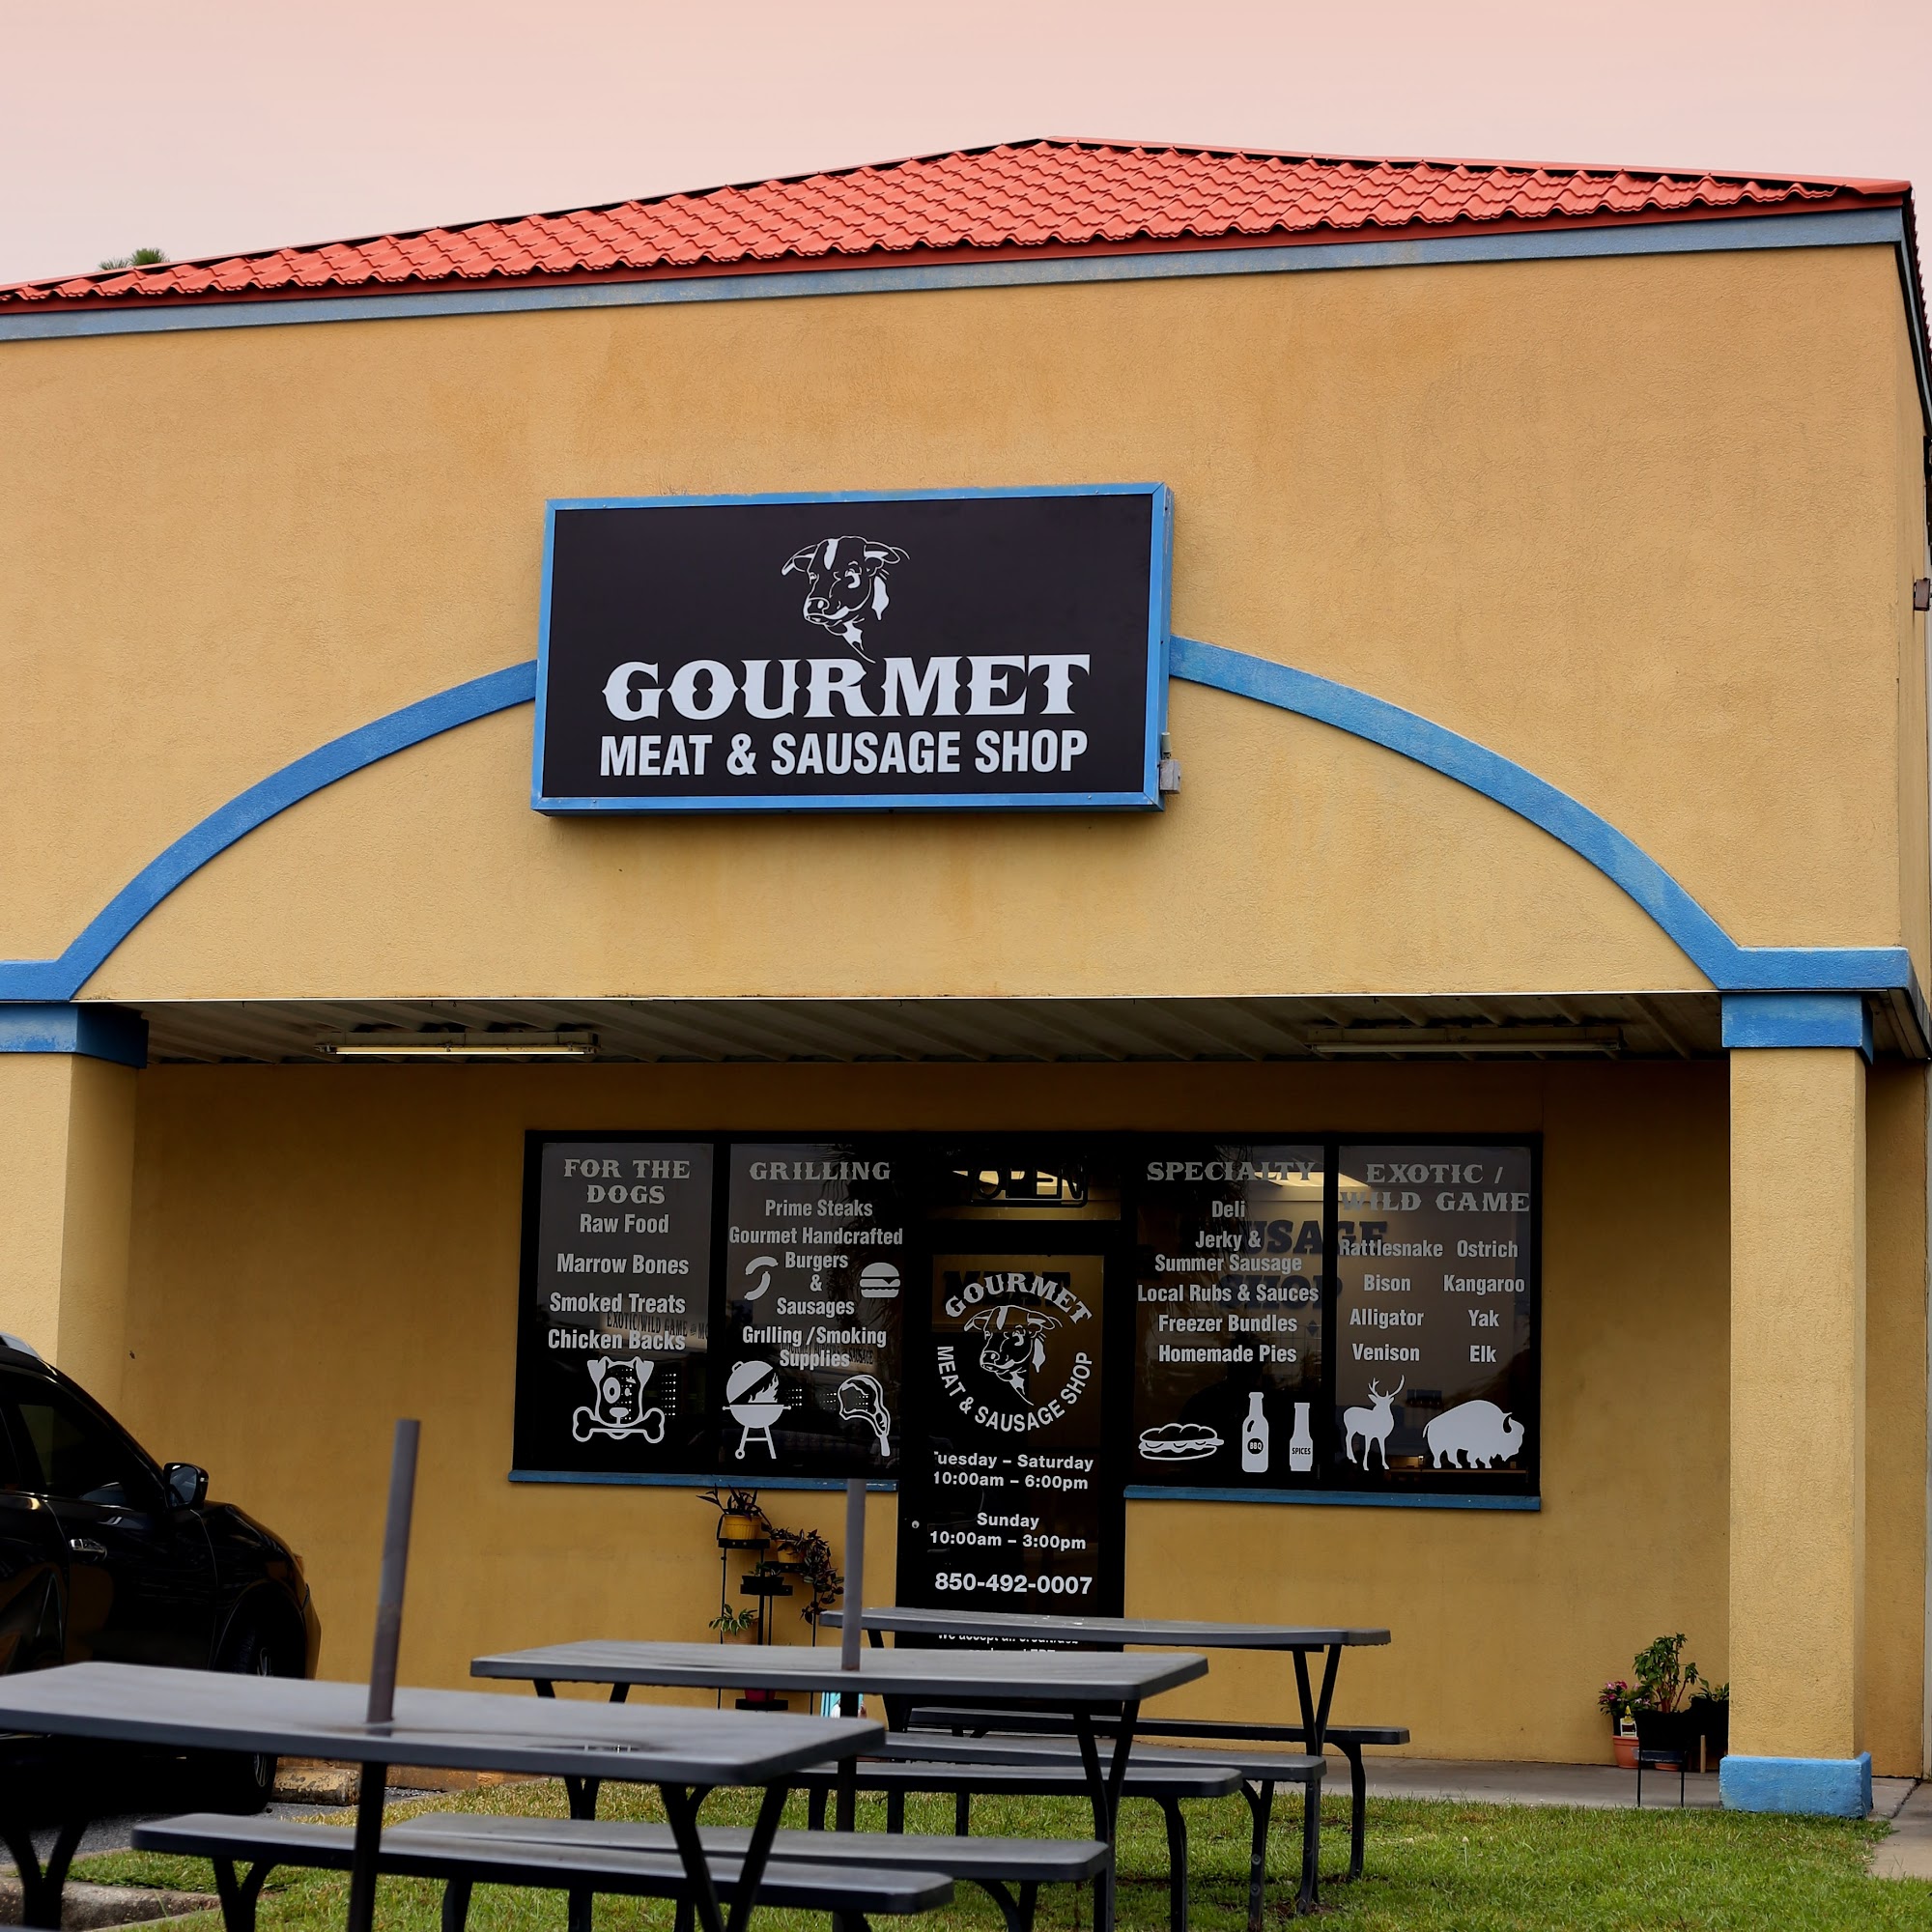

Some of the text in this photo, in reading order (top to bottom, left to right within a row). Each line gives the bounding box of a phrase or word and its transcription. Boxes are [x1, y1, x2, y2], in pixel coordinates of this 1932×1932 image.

[602, 654, 1091, 722] GOURMET
[600, 729, 1089, 777] MEAT & SAUSAGE SHOP
[563, 1158, 691, 1179] FOR THE
[749, 1161, 891, 1181] GRILLING
[1147, 1161, 1316, 1182] SPECIALTY
[1366, 1163, 1503, 1184] EXOTIC /
[586, 1184, 666, 1205] DOGS
[1340, 1191, 1530, 1212] WILD GAME
[765, 1199, 873, 1217] Prime Steaks
[1211, 1200, 1245, 1218] Deli
[580, 1213, 669, 1234] Raw Food
[728, 1226, 903, 1246] Gourmet Handcrafted
[1195, 1231, 1262, 1252] Jerky &
[1339, 1239, 1443, 1258] Rattlesnake
[1457, 1239, 1519, 1259] Ostrich
[556, 1253, 689, 1275] Marrow Bones
[784, 1252, 848, 1273] Burgers
[1154, 1254, 1302, 1275] Summer Sausage
[810, 1274, 823, 1293] &
[1137, 1284, 1320, 1303] Local Rubs & Sauces
[1363, 1274, 1411, 1293] Bison
[1443, 1275, 1526, 1295] Kangaroo
[550, 1293, 686, 1314] Smoked Treats
[777, 1297, 855, 1319] Sausages
[945, 1273, 1093, 1323] GOURMET
[1158, 1315, 1297, 1333] Freezer Bundles
[1350, 1308, 1424, 1330] Alligator
[1468, 1310, 1499, 1328] Yak
[548, 1328, 686, 1350] Chicken Backs
[742, 1325, 803, 1347] Grilling
[780, 1350, 850, 1371] Supplies
[1158, 1345, 1297, 1363] Homemade Pies
[1352, 1344, 1421, 1362] Venison
[1469, 1346, 1497, 1363] Elk
[937, 1346, 1093, 1433] MEAT & SAUSAGE SHOP
[934, 1451, 997, 1469] uesday
[1017, 1454, 1094, 1472] Saturday
[934, 1471, 1004, 1487] 10:00am
[1025, 1475, 1089, 1492] 6:00pm
[977, 1512, 1039, 1530] Sunday
[930, 1530, 1002, 1546] 10:00am
[1022, 1535, 1086, 1551] 3:00pm
[935, 1573, 1093, 1594] 850-492-0007
